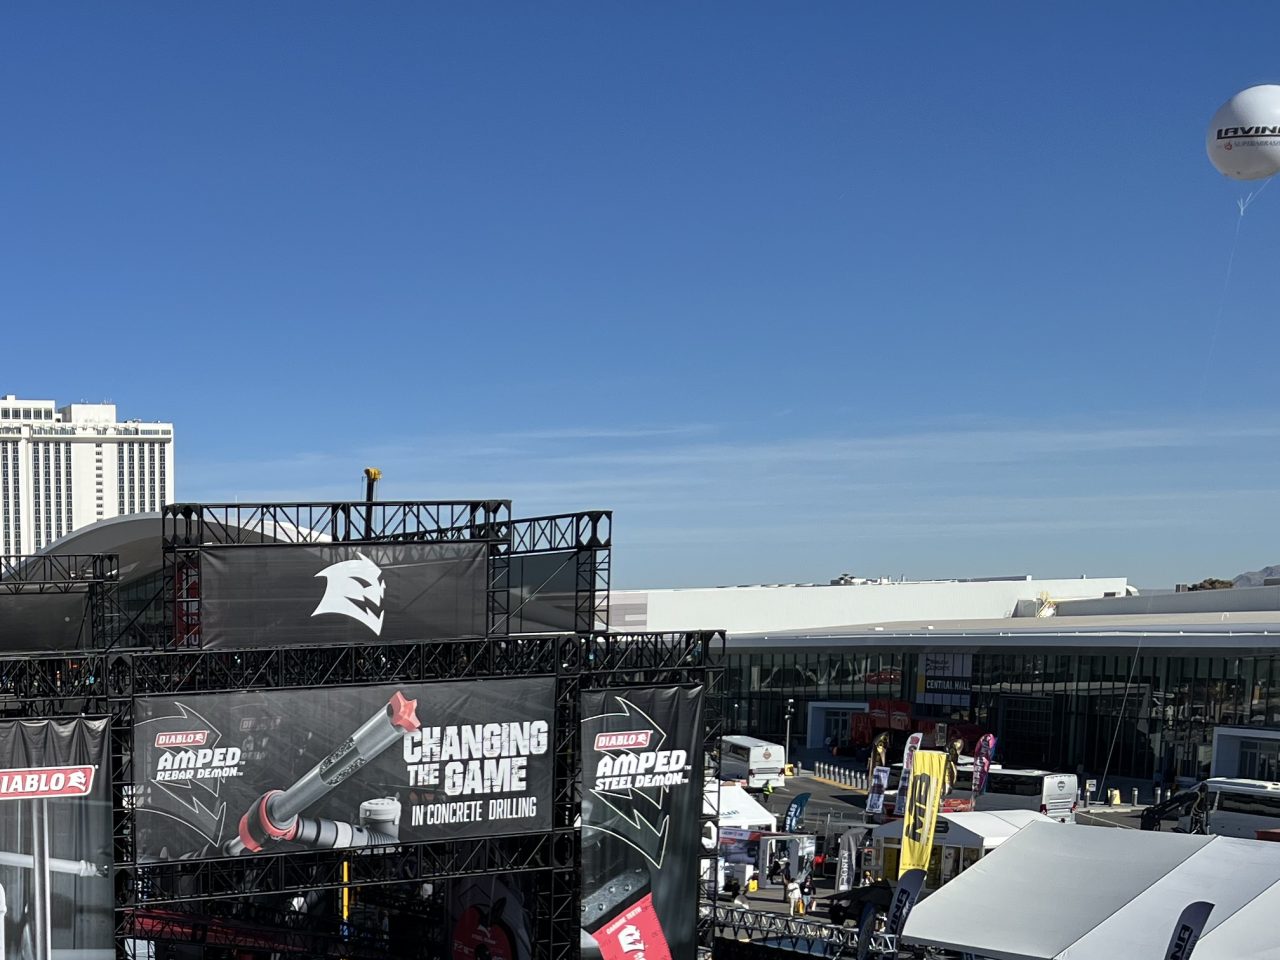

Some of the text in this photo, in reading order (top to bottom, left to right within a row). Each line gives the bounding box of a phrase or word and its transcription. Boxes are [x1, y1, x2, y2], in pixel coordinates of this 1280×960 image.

[1216, 126, 1280, 140] LAVIN
[158, 733, 194, 744] DIABLO
[404, 720, 549, 762] CHANGING
[598, 735, 637, 748] DIABLO
[157, 747, 241, 771] AMPED
[596, 749, 687, 778] AMPED
[156, 766, 237, 781] REBAR DEMON
[407, 757, 527, 796] THE GAME
[595, 773, 682, 791] STEEL DEMON
[412, 797, 537, 826] IN CONCRETE DRILLING
